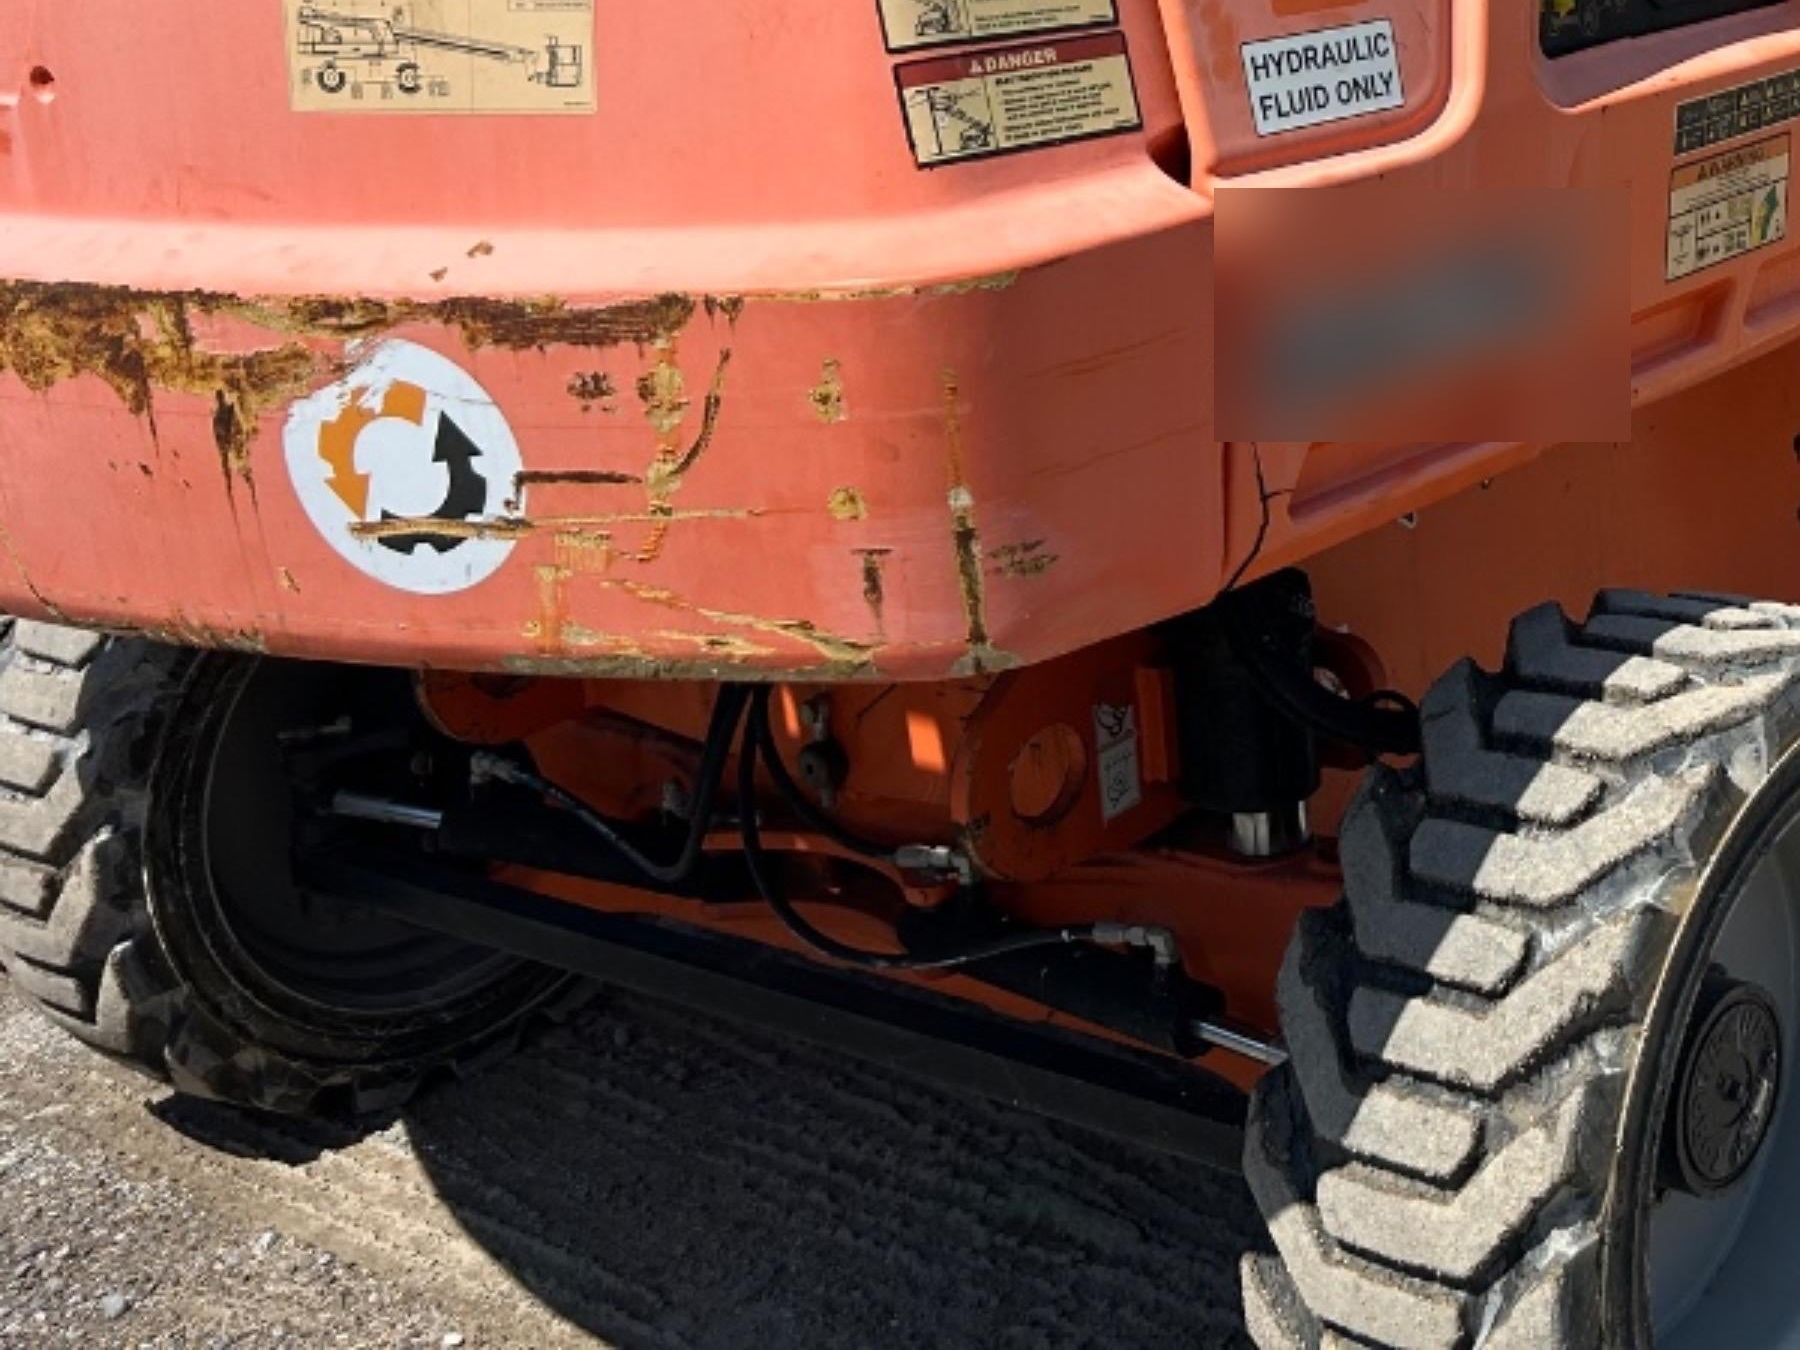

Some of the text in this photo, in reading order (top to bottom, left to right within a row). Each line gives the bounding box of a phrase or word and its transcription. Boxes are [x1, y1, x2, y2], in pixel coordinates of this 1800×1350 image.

[985, 47, 1057, 72] DANGER
[1250, 32, 1391, 82] HYDRAULIC
[1258, 71, 1394, 121] FLUID ONLY
